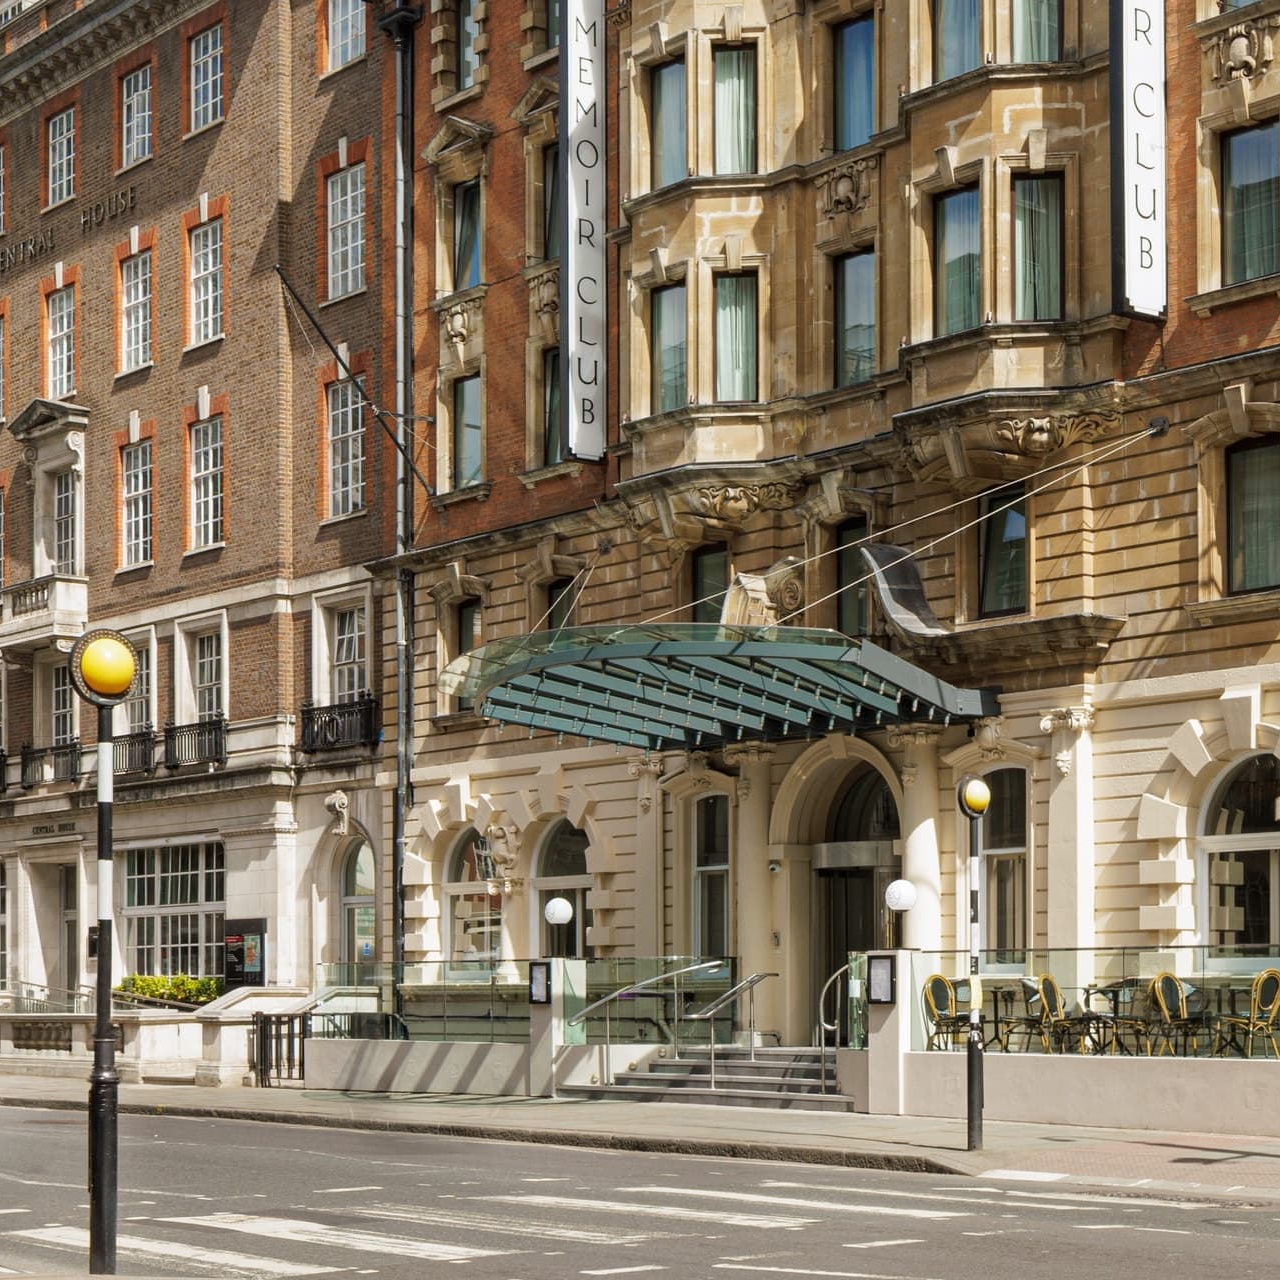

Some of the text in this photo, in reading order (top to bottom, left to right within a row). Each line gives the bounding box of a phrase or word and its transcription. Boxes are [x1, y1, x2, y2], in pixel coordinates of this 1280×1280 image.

[81, 186, 137, 233] HOUSE
[575, 16, 599, 248] MEMOIR
[1133, 82, 1157, 270] CLUB
[576, 276, 599, 425] CLUB
